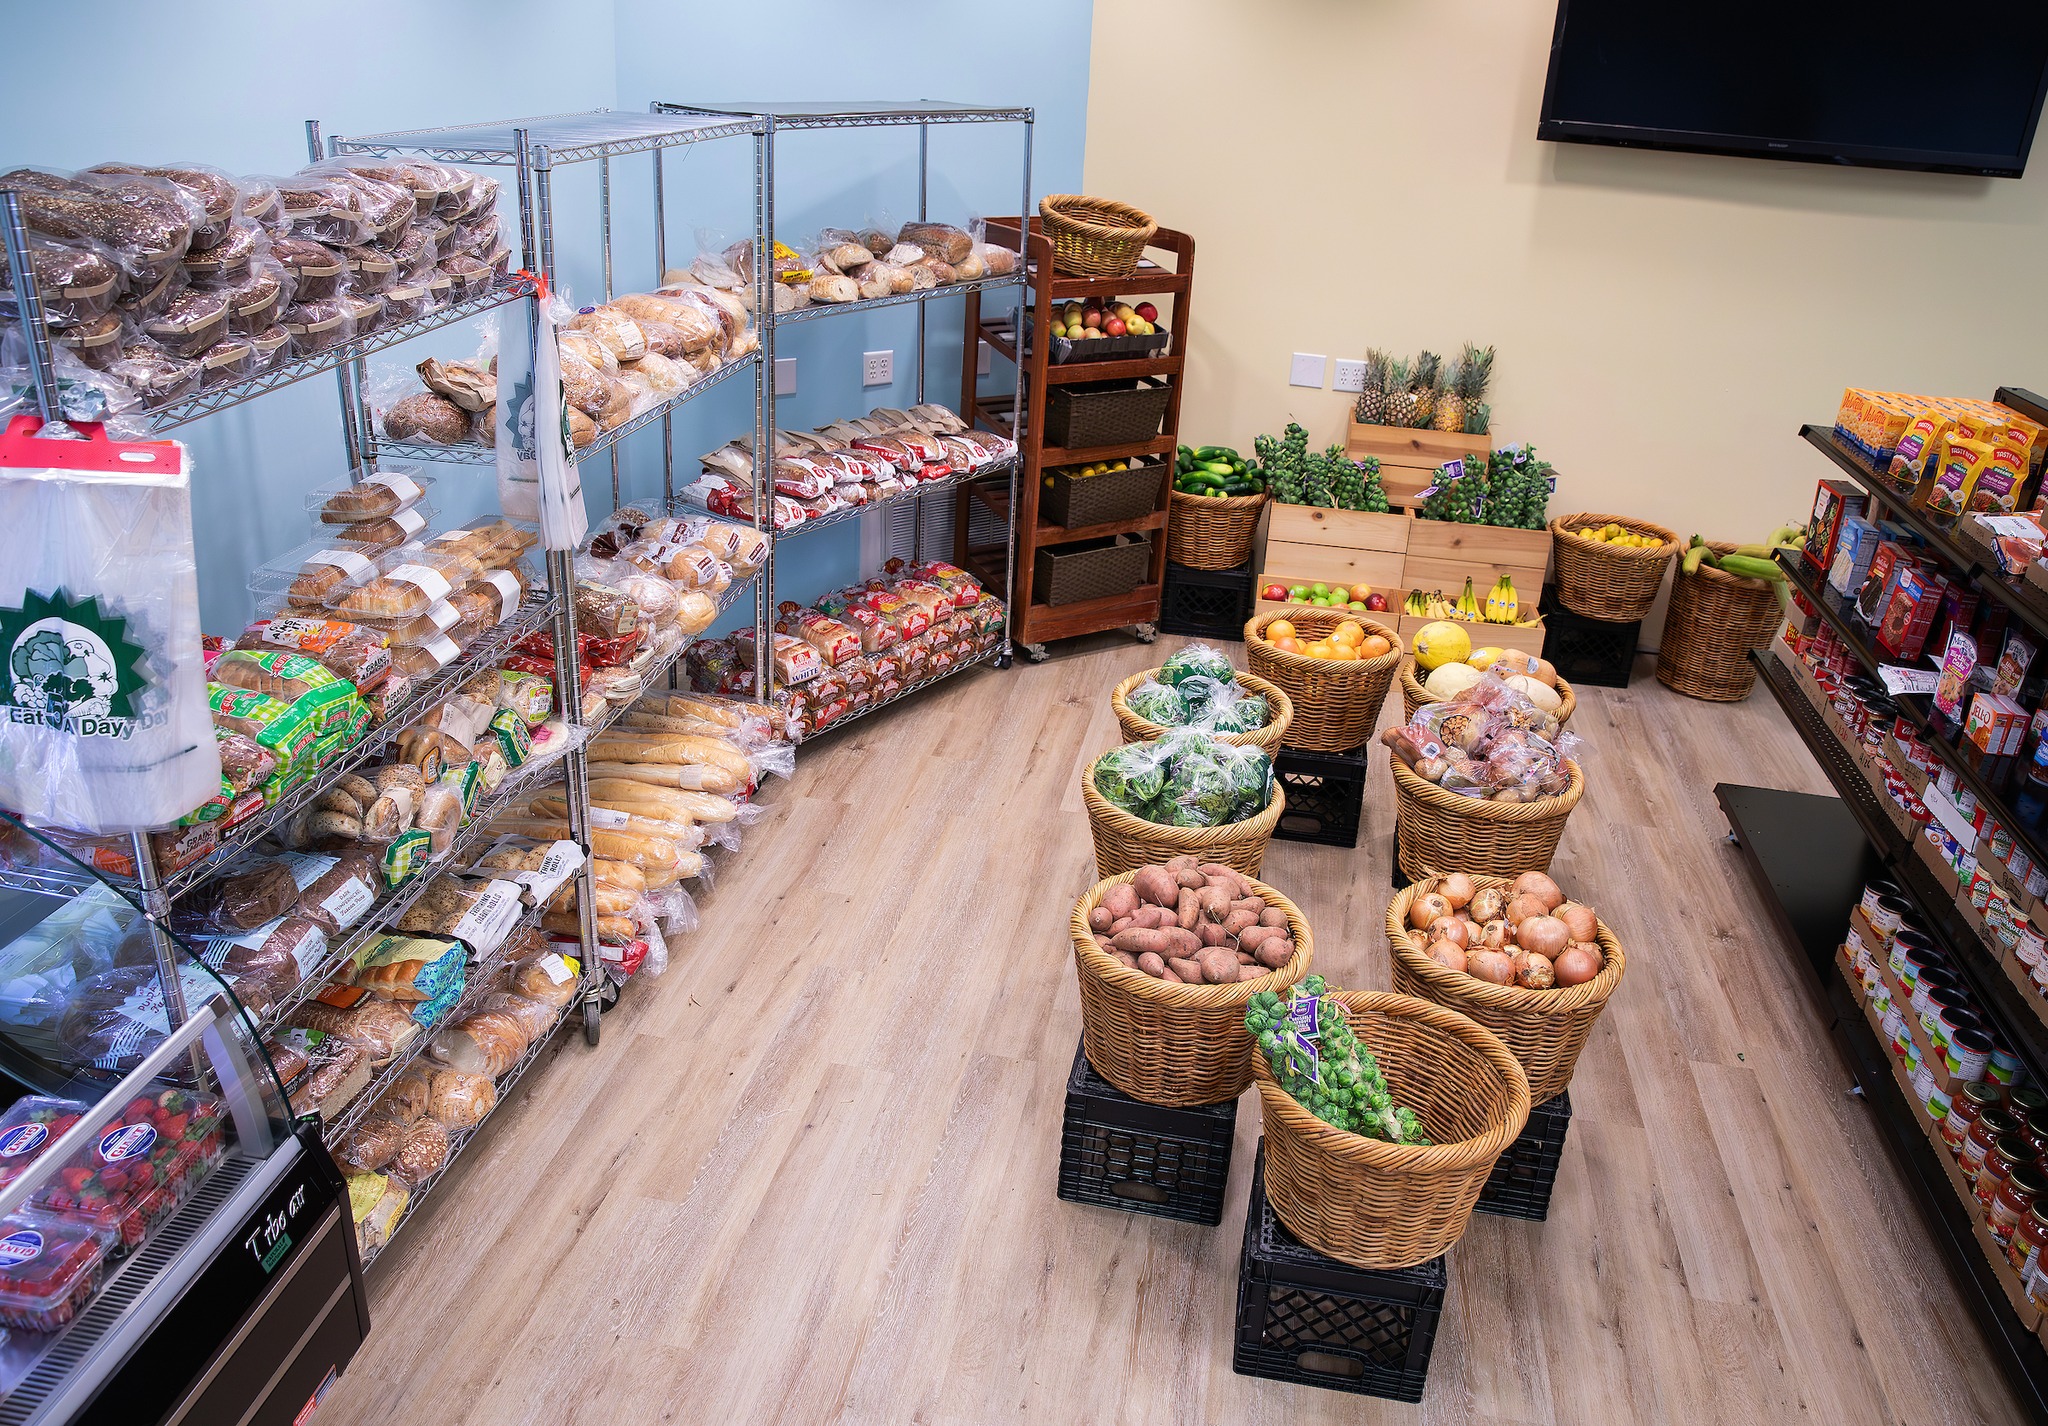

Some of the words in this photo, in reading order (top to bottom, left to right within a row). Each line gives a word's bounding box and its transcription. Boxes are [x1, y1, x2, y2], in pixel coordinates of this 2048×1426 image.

[1863, 405, 1887, 425] Velveeta
[1951, 447, 1965, 456] TASTY
[1965, 449, 1977, 463] BITE
[1996, 450, 2010, 459] TASTY
[2010, 454, 2021, 467] BITE
[1995, 467, 2013, 478] ORGANIC
[366, 653, 387, 673] GRAINS
[1951, 657, 1967, 672] Cake
[791, 666, 819, 682] WHITE
[390, 682, 407, 701] GRAINS
[10, 707, 45, 726] Eat
[63, 721, 75, 736] A
[82, 717, 124, 737] Day
[1970, 703, 1991, 724] JELL-O
[233, 801, 264, 823] SEEDED
[540, 855, 553, 876] THING
[549, 854, 562, 873] ROLLS
[338, 889, 351, 901] DARK
[1974, 884, 1990, 894] BOYA
[487, 892, 502, 912] ROLLS
[8, 1126, 40, 1153] GIANT
[110, 1126, 146, 1158] GIANT
[288, 1183, 306, 1219] air
